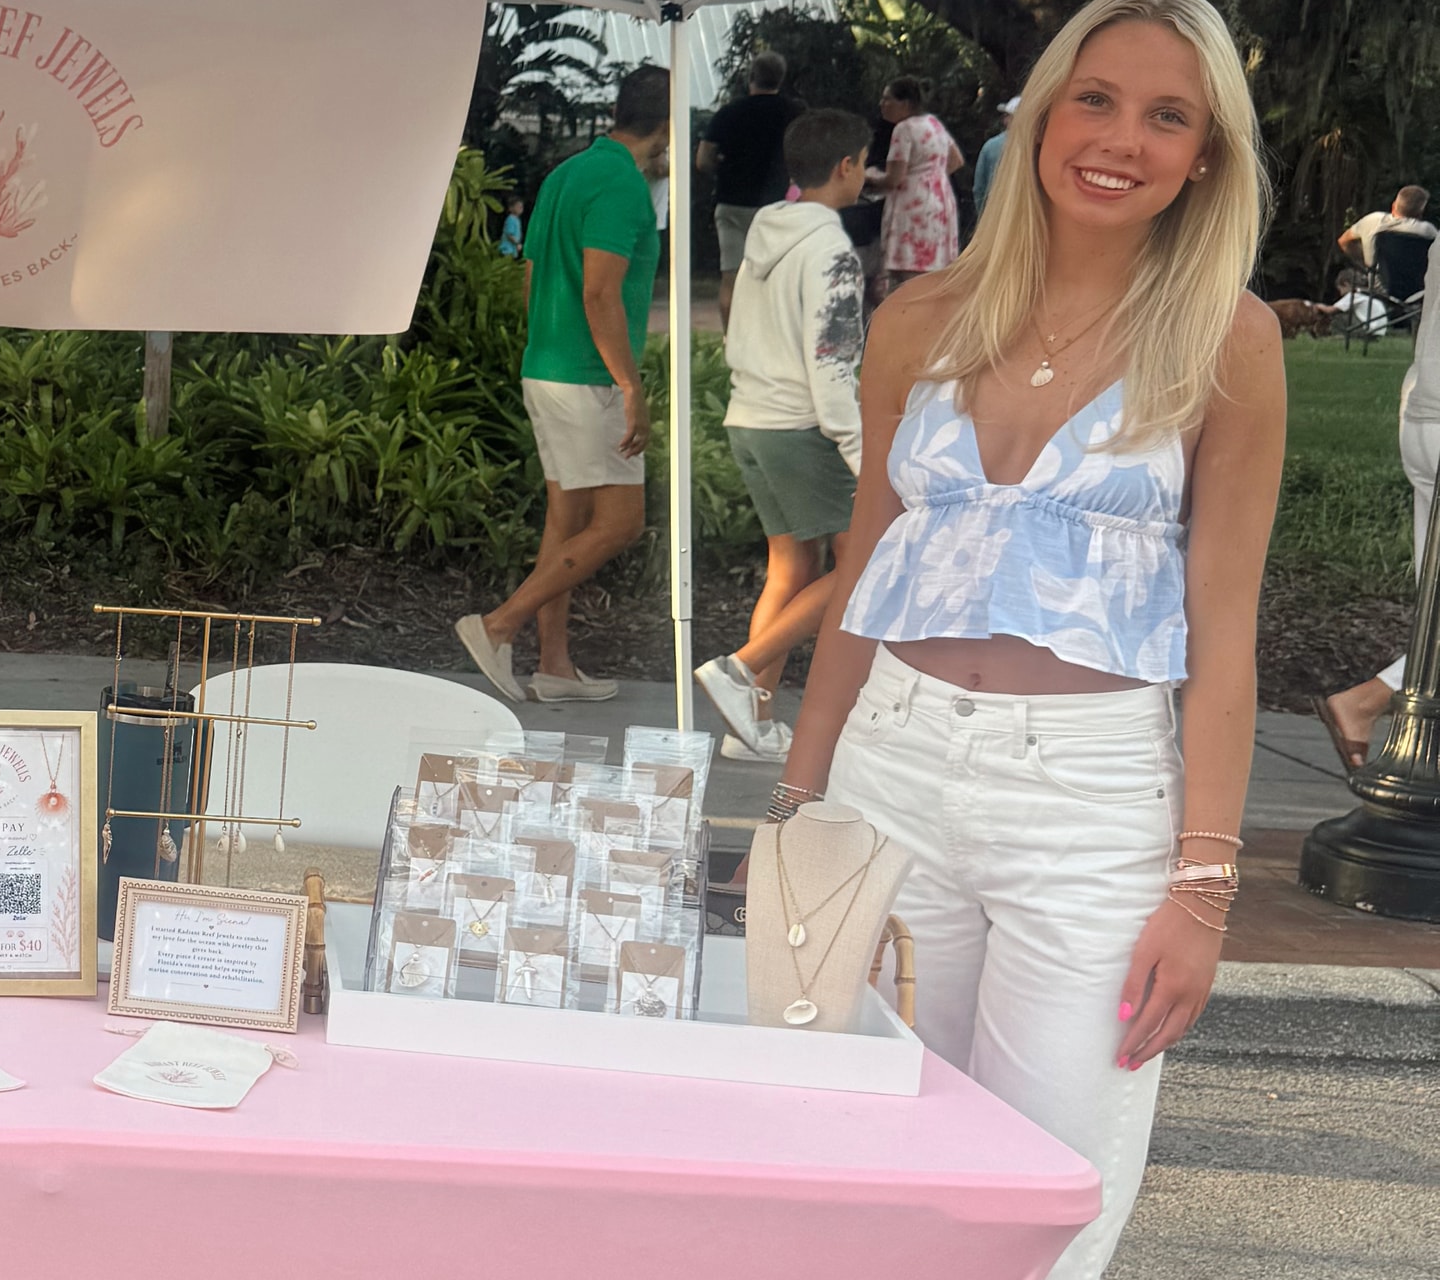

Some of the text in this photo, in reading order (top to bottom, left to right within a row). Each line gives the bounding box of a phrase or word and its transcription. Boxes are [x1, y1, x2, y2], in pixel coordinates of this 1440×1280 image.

[34, 26, 144, 149] JEWELS
[2, 822, 25, 832] PAY
[177, 928, 200, 936] Radiant
[216, 932, 235, 940] Jewels
[0, 943, 17, 951] FOR
[19, 939, 42, 952] $40
[231, 943, 253, 951] jewelry
[157, 951, 174, 959] Every
[224, 958, 248, 966] inspired
[157, 959, 183, 967] Florida's
[214, 965, 230, 973] helps
[231, 967, 255, 975] support
[170, 969, 208, 978] conservation
